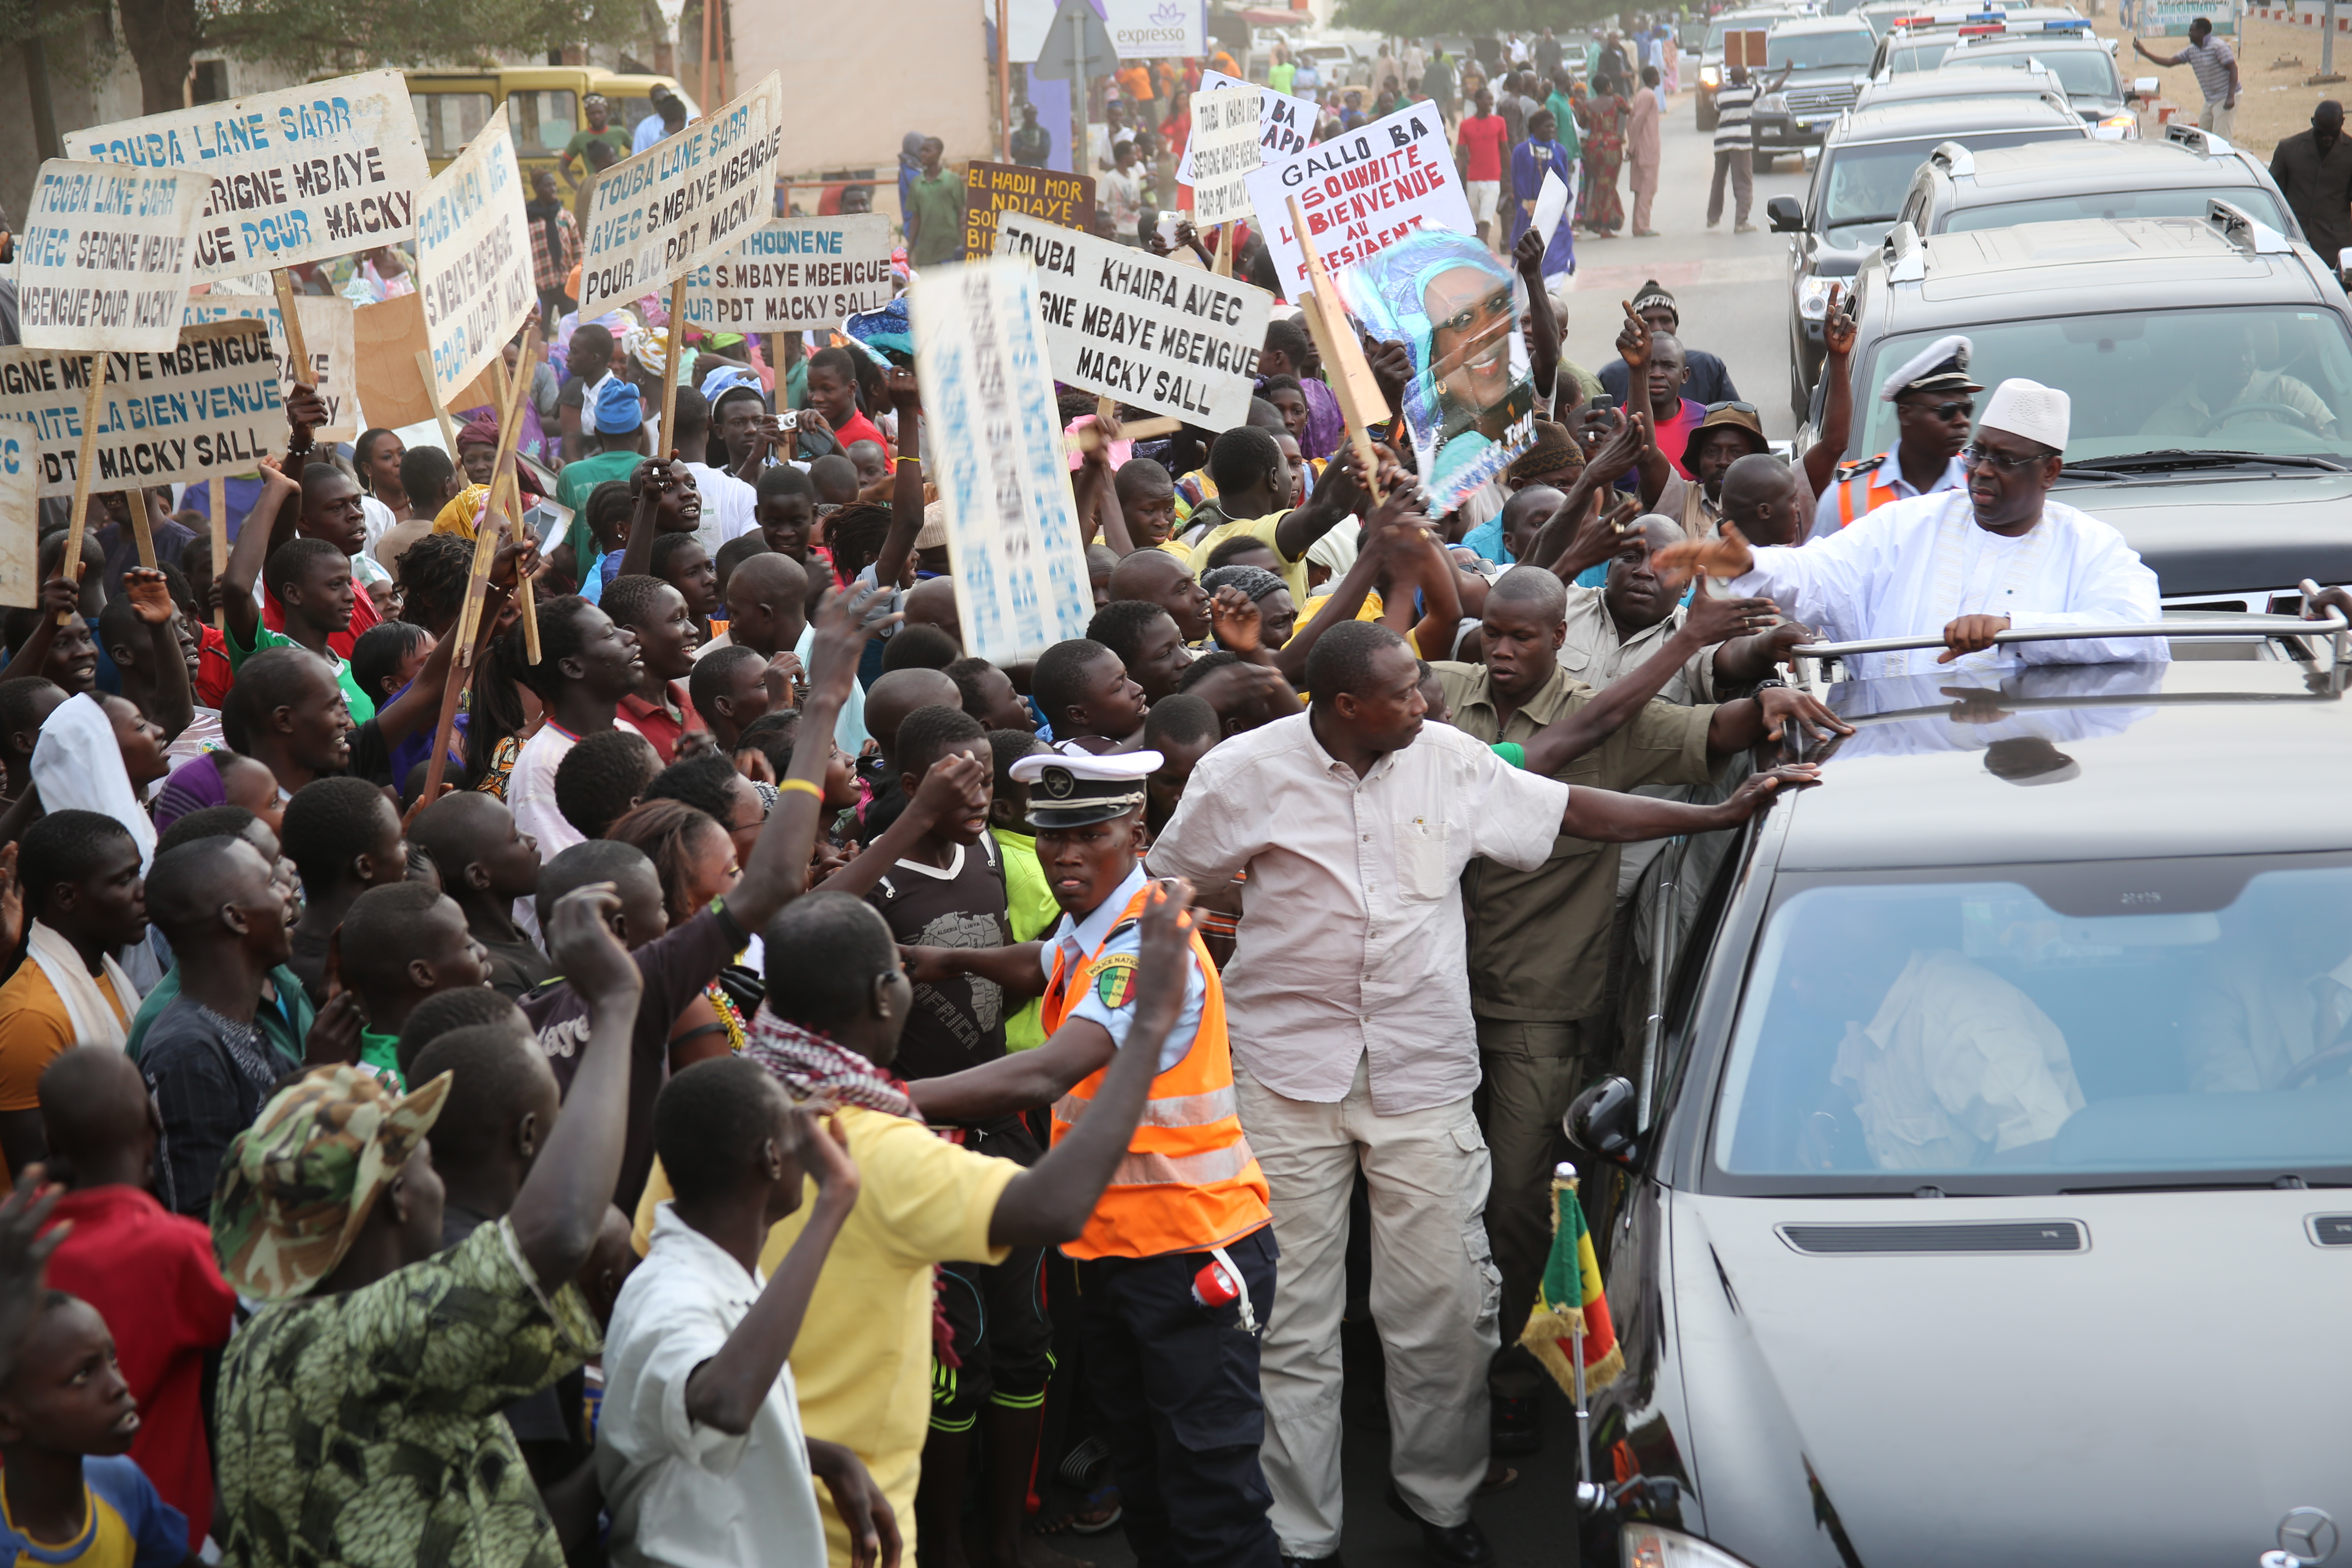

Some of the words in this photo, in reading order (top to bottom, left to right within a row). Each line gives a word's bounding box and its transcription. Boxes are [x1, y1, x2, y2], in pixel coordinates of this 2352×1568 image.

[1118, 28, 1185, 45] expresso
[89, 129, 185, 167] TOUBA
[193, 113, 269, 159] LANE
[279, 96, 352, 142] SARR
[1271, 98, 1295, 128] BA
[293, 147, 385, 198] MBAYE
[599, 156, 654, 211] TOUBA
[660, 133, 702, 182] LANE
[710, 105, 748, 156] SARR
[1195, 147, 1220, 180] SERIGNE
[1282, 137, 1371, 186] GALLO
[1388, 117, 1428, 148] BA
[1302, 144, 1421, 209] SOUHAITE
[40, 174, 93, 213] TOUBA
[94, 176, 136, 215] LANE
[140, 178, 176, 216] SARR
[590, 208, 643, 256] AVEC
[647, 169, 716, 233] S.MBAYE
[720, 125, 782, 195] MBENGUE
[968, 169, 986, 188] EL
[991, 171, 1036, 195] HADJI
[1045, 178, 1083, 202] MOR
[991, 192, 1073, 221] NDIAYE
[1198, 189, 1215, 218] POUR
[1215, 185, 1227, 215] PDT
[1307, 161, 1445, 235] BIENVENUE
[241, 209, 311, 257] POUR
[323, 190, 411, 241] MACKY
[586, 258, 633, 305] POUR
[638, 247, 662, 283] AU
[666, 222, 699, 270] PDT
[708, 185, 758, 245] MACKY
[1348, 220, 1369, 241] AU
[24, 227, 69, 267] AVEC
[76, 231, 140, 270] SERIGNE
[140, 234, 185, 274] MBAYE
[716, 263, 802, 289] S.MBAYE
[805, 259, 890, 287] MBENGUE
[1006, 226, 1076, 276] TOUBA
[1100, 257, 1178, 309] KHAIRA
[1183, 283, 1243, 326] AVEC
[22, 286, 90, 327] MBENGUE
[91, 289, 129, 327] POUR
[133, 290, 178, 328] MACKY
[717, 298, 754, 323] PDT
[766, 295, 829, 321] MACKY
[835, 290, 885, 317] SALL
[158, 330, 274, 376] MBENGUE
[434, 325, 468, 393] POUR
[468, 307, 483, 359] AU
[482, 281, 501, 345] PDT
[1082, 303, 1156, 351] MBAYE
[1161, 325, 1261, 379] MBENGUE
[127, 391, 189, 431] BIEN
[191, 379, 282, 420] VENUE
[1077, 347, 1152, 395] MACKY
[1155, 372, 1211, 416] SALL
[98, 438, 186, 480] MACKY
[194, 428, 267, 466] SALL
[937, 927, 958, 935] ALGERIA
[1090, 960, 1112, 974] POLICE
[913, 983, 979, 1050] AFRICA
